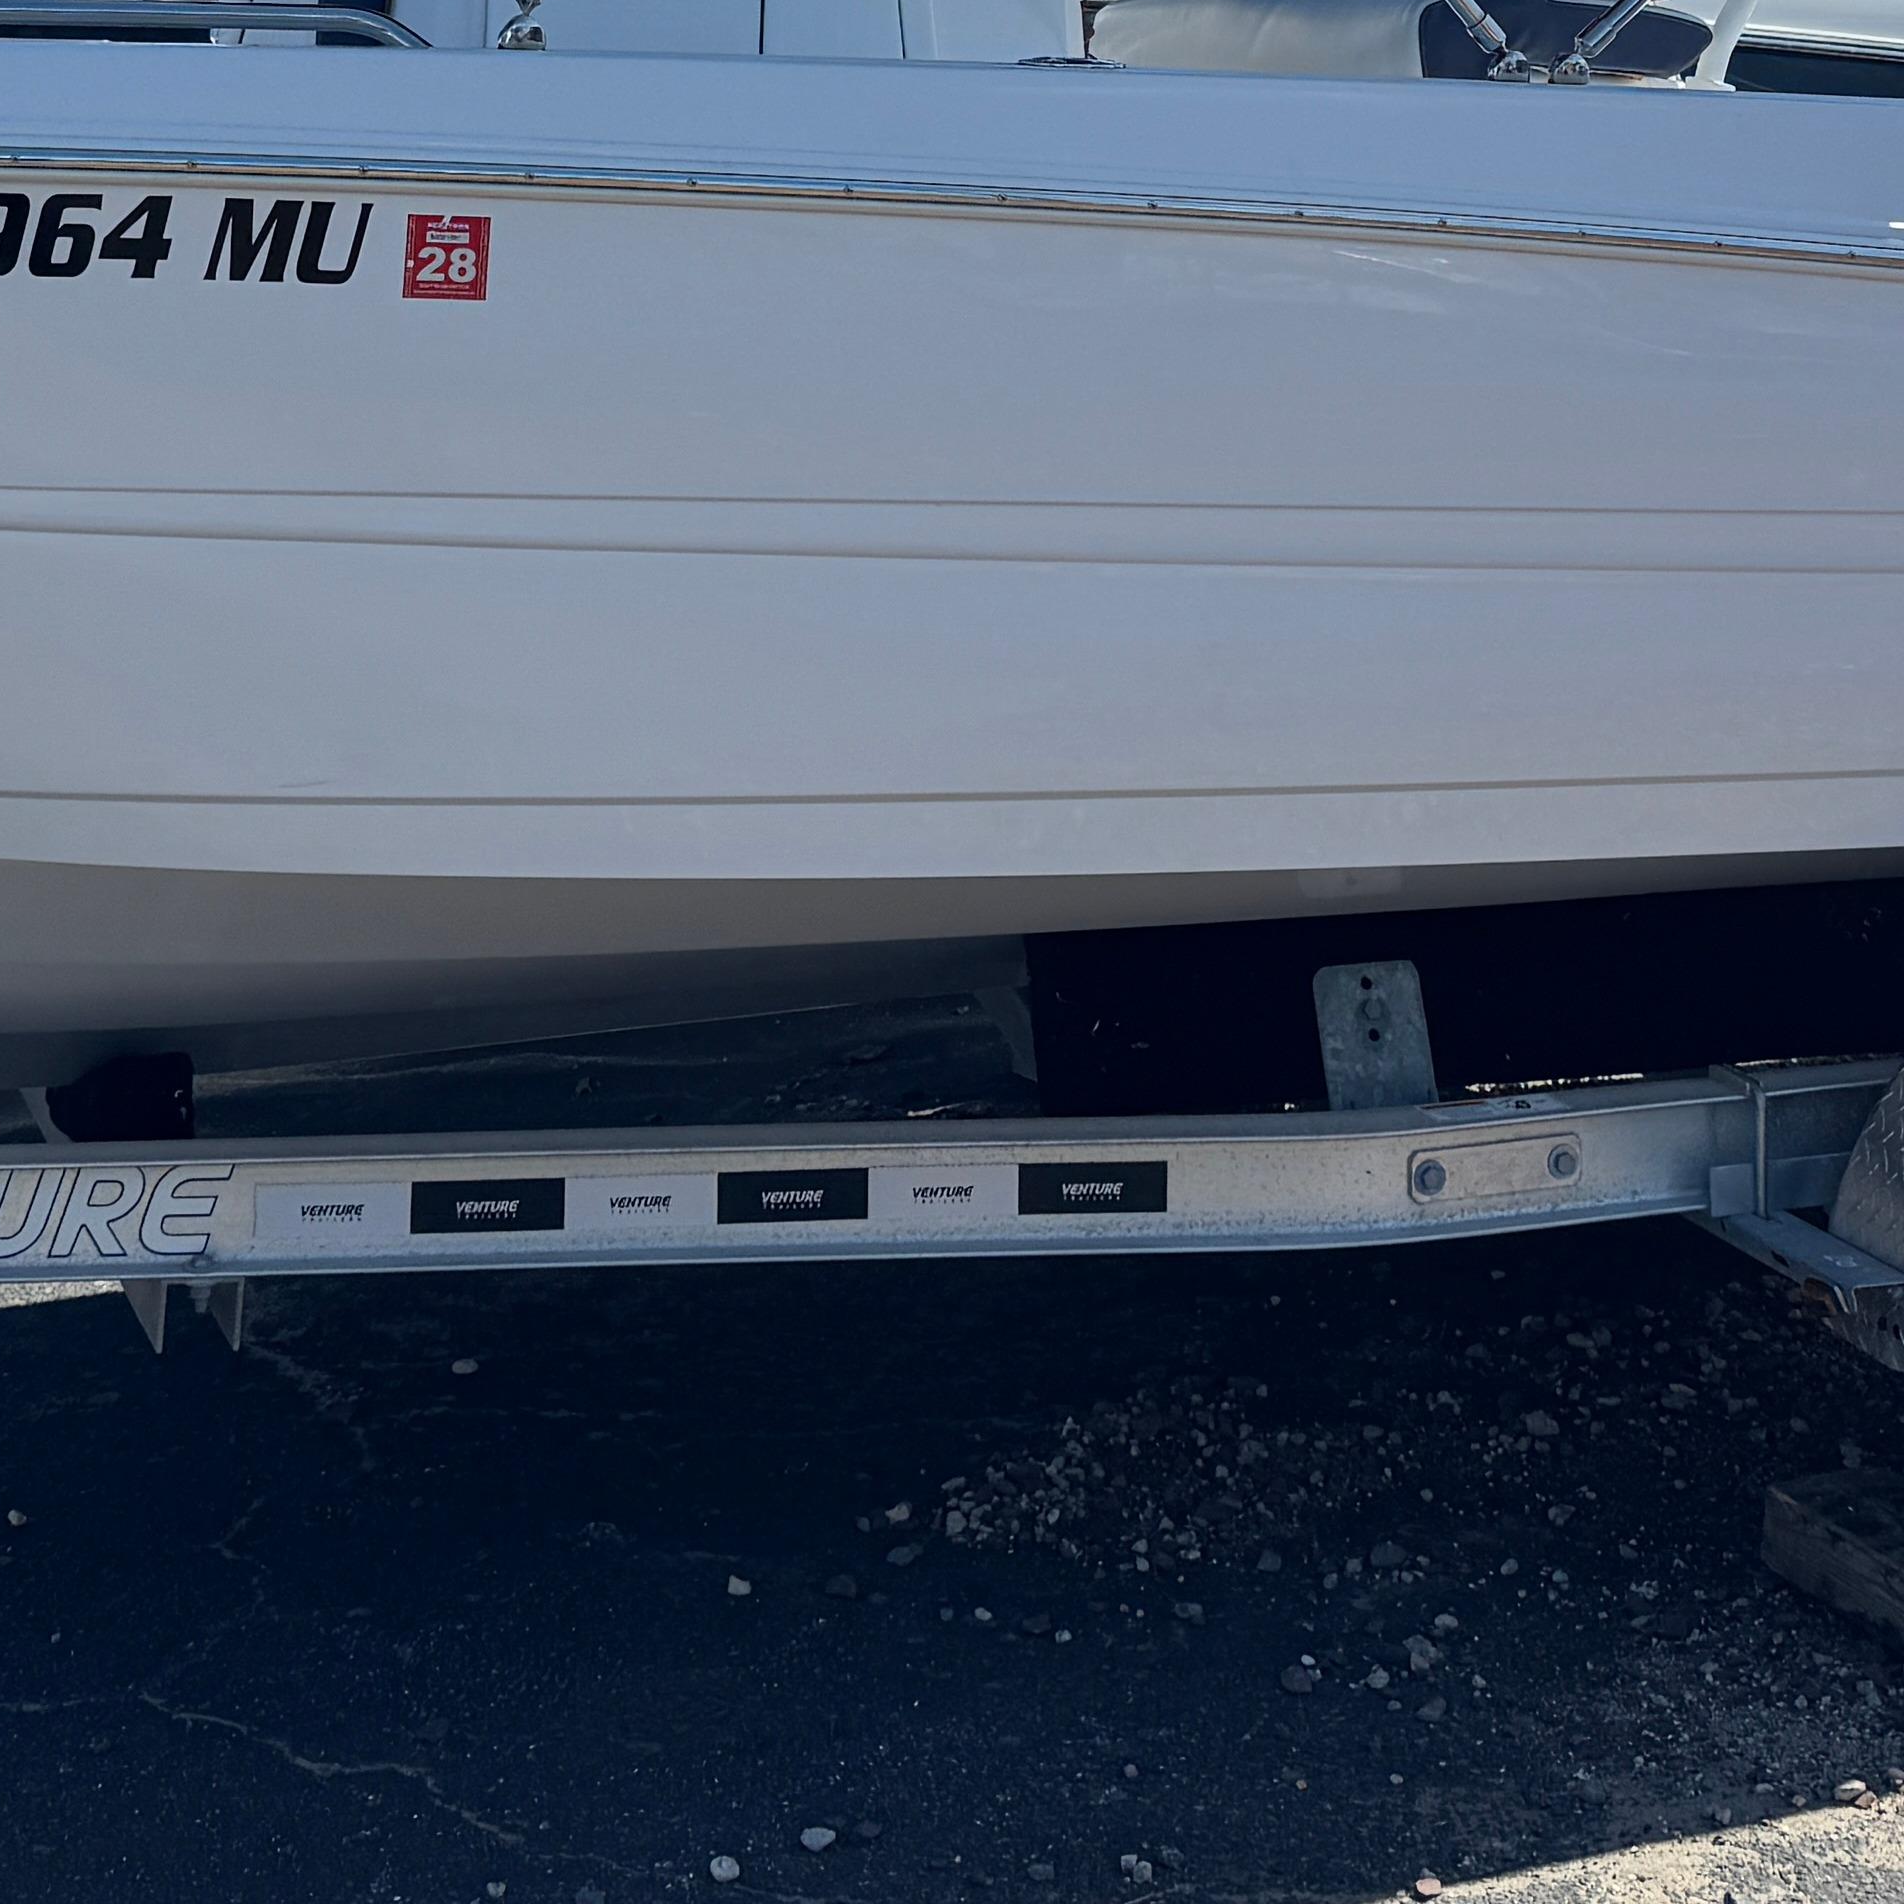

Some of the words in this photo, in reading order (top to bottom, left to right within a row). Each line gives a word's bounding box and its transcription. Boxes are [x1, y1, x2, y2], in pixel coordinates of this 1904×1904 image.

[203, 196, 375, 286] MU
[416, 246, 477, 284] 28
[913, 1185, 974, 1198] VENTURE
[1062, 1183, 1123, 1195] VENTURE
[610, 1195, 672, 1208] VENTURE
[762, 1190, 824, 1203] VENTURE
[301, 1204, 365, 1216] VENTURE
[456, 1200, 519, 1213] VENTURE
